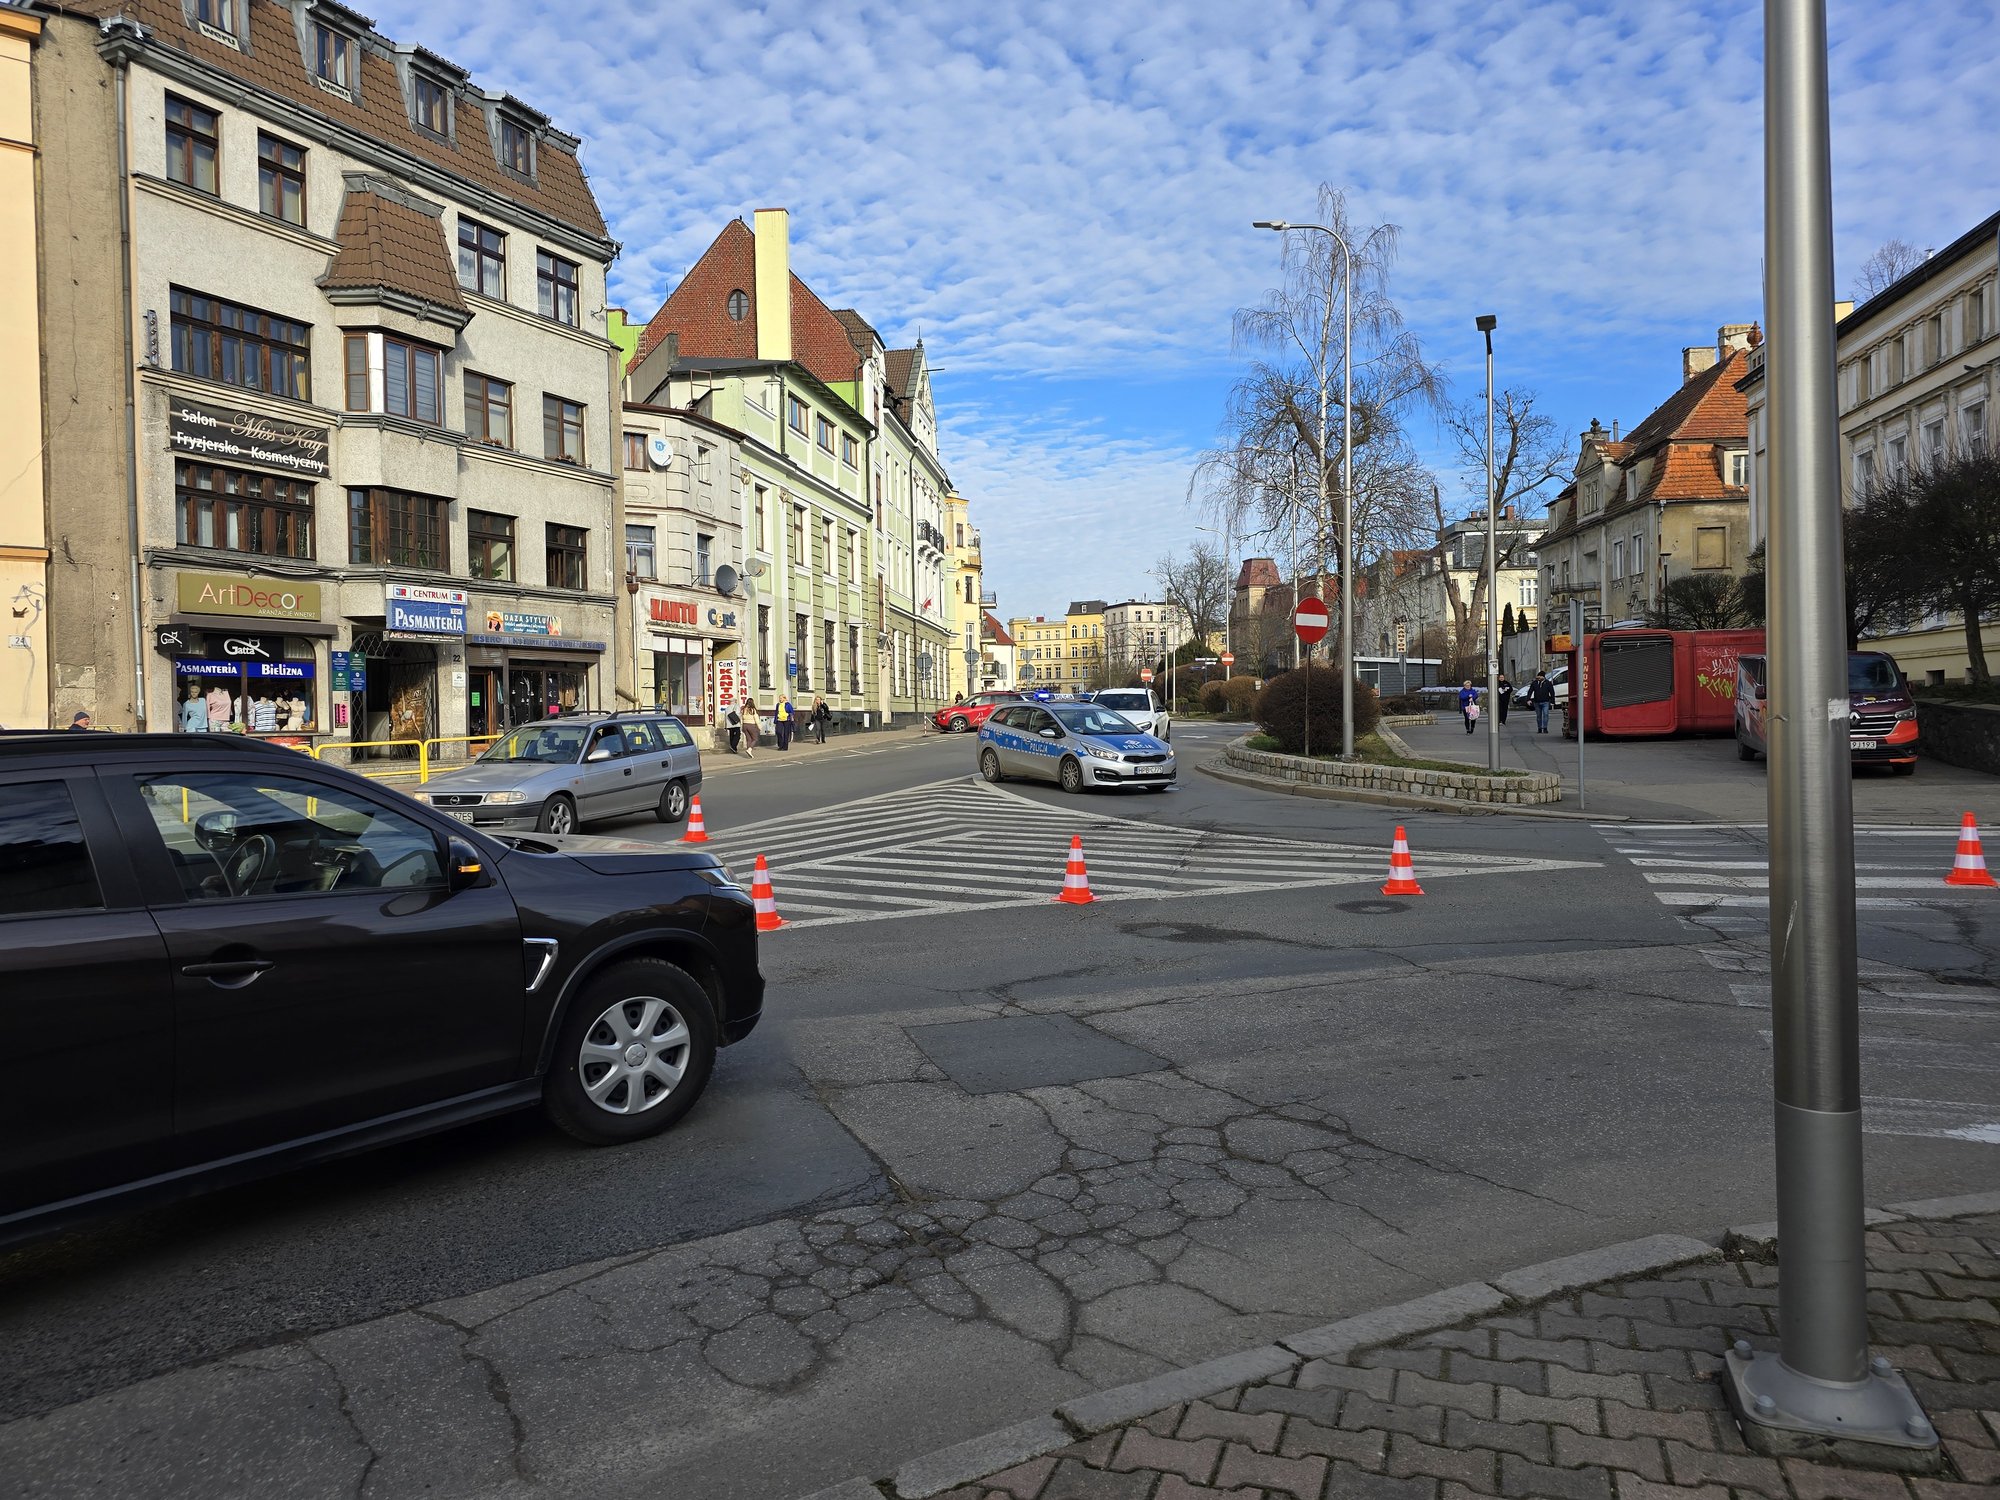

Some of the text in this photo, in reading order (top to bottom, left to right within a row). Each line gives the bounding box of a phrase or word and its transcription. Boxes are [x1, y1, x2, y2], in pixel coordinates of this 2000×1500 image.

[182, 409, 217, 428] Salon
[231, 413, 324, 458] Miss Kay
[176, 431, 239, 455] Fryzjersko
[251, 446, 325, 473] Kosmetyczny
[198, 582, 304, 611] ArtDecor
[413, 590, 448, 599] CENTRUM
[650, 598, 698, 625] KANTO
[223, 638, 270, 658] Gatta
[739, 670, 748, 706] KANT
